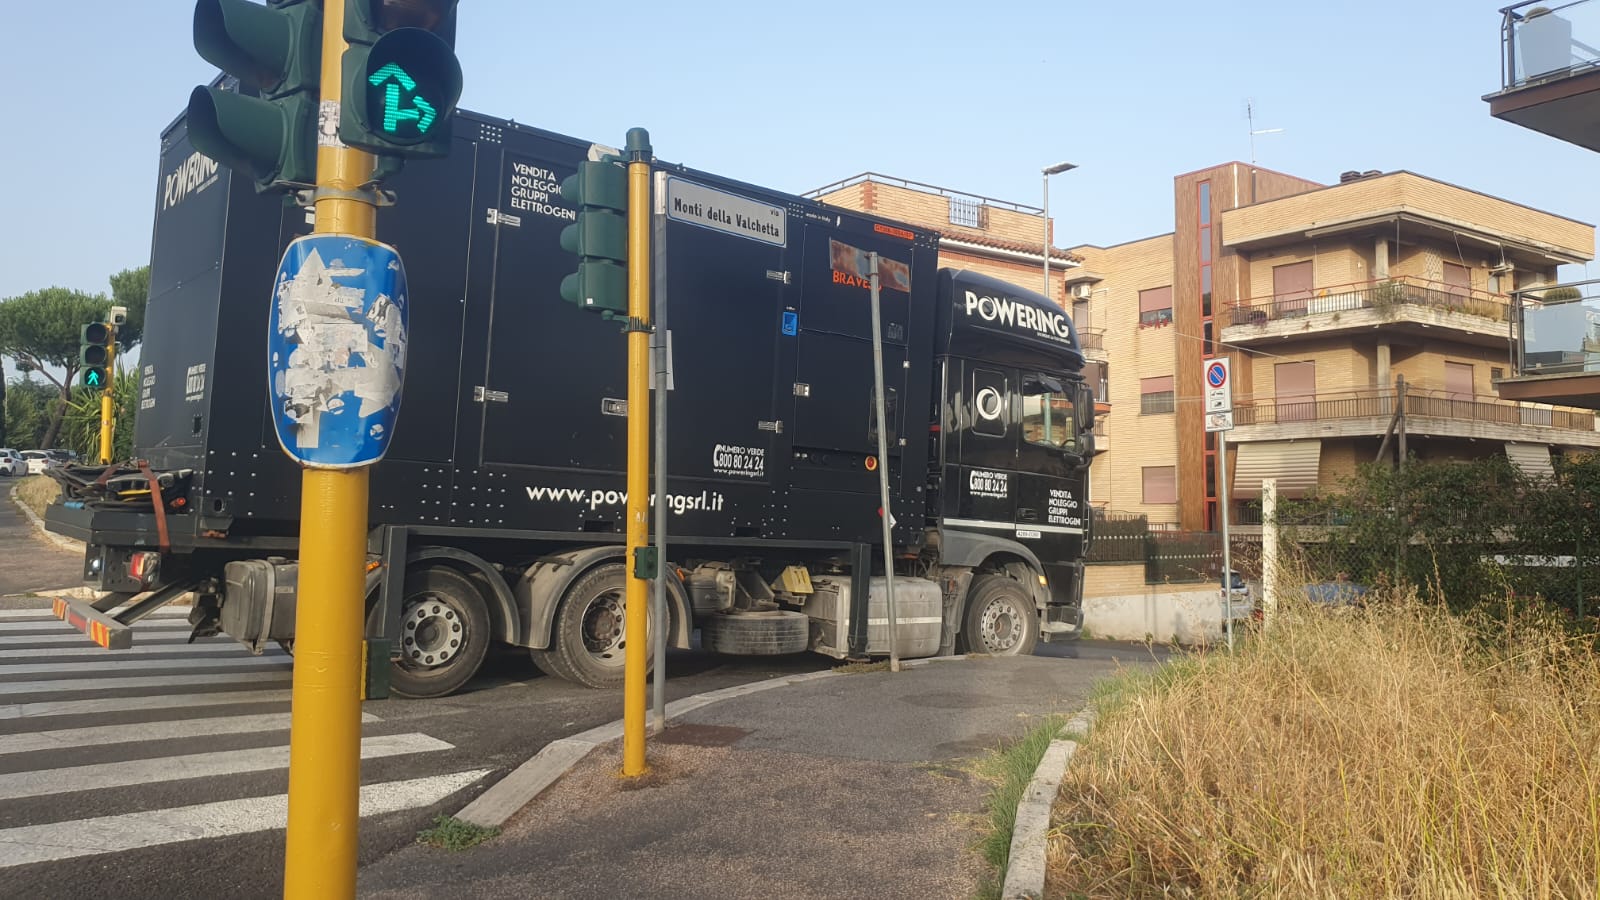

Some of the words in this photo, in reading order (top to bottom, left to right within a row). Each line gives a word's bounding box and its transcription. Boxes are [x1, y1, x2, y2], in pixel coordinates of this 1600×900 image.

[513, 162, 556, 181] VENDITA
[511, 175, 562, 194] NOLEGGI
[511, 186, 548, 203] GRUPPI
[511, 197, 576, 221] ELETTROGENI
[674, 197, 703, 217] Monti
[707, 206, 732, 225] della
[736, 213, 780, 237] Valchetta
[770, 208, 780, 217] via
[965, 290, 1069, 337] POWERING
[719, 444, 746, 455] NUMERO
[747, 447, 765, 456] VERDE
[719, 452, 732, 468] 800
[733, 454, 743, 469] 80
[744, 455, 753, 469] 24
[754, 456, 764, 471] 24
[992, 479, 999, 492] 24
[1000, 480, 1007, 493] 24
[1049, 489, 1072, 499] VENDITA
[526, 485, 724, 515] www.porngsrl.it
[1048, 497, 1078, 509] NOLEGGIO
[1048, 506, 1068, 516] GRUPPI
[1048, 515, 1081, 526] ELETTROGENI
